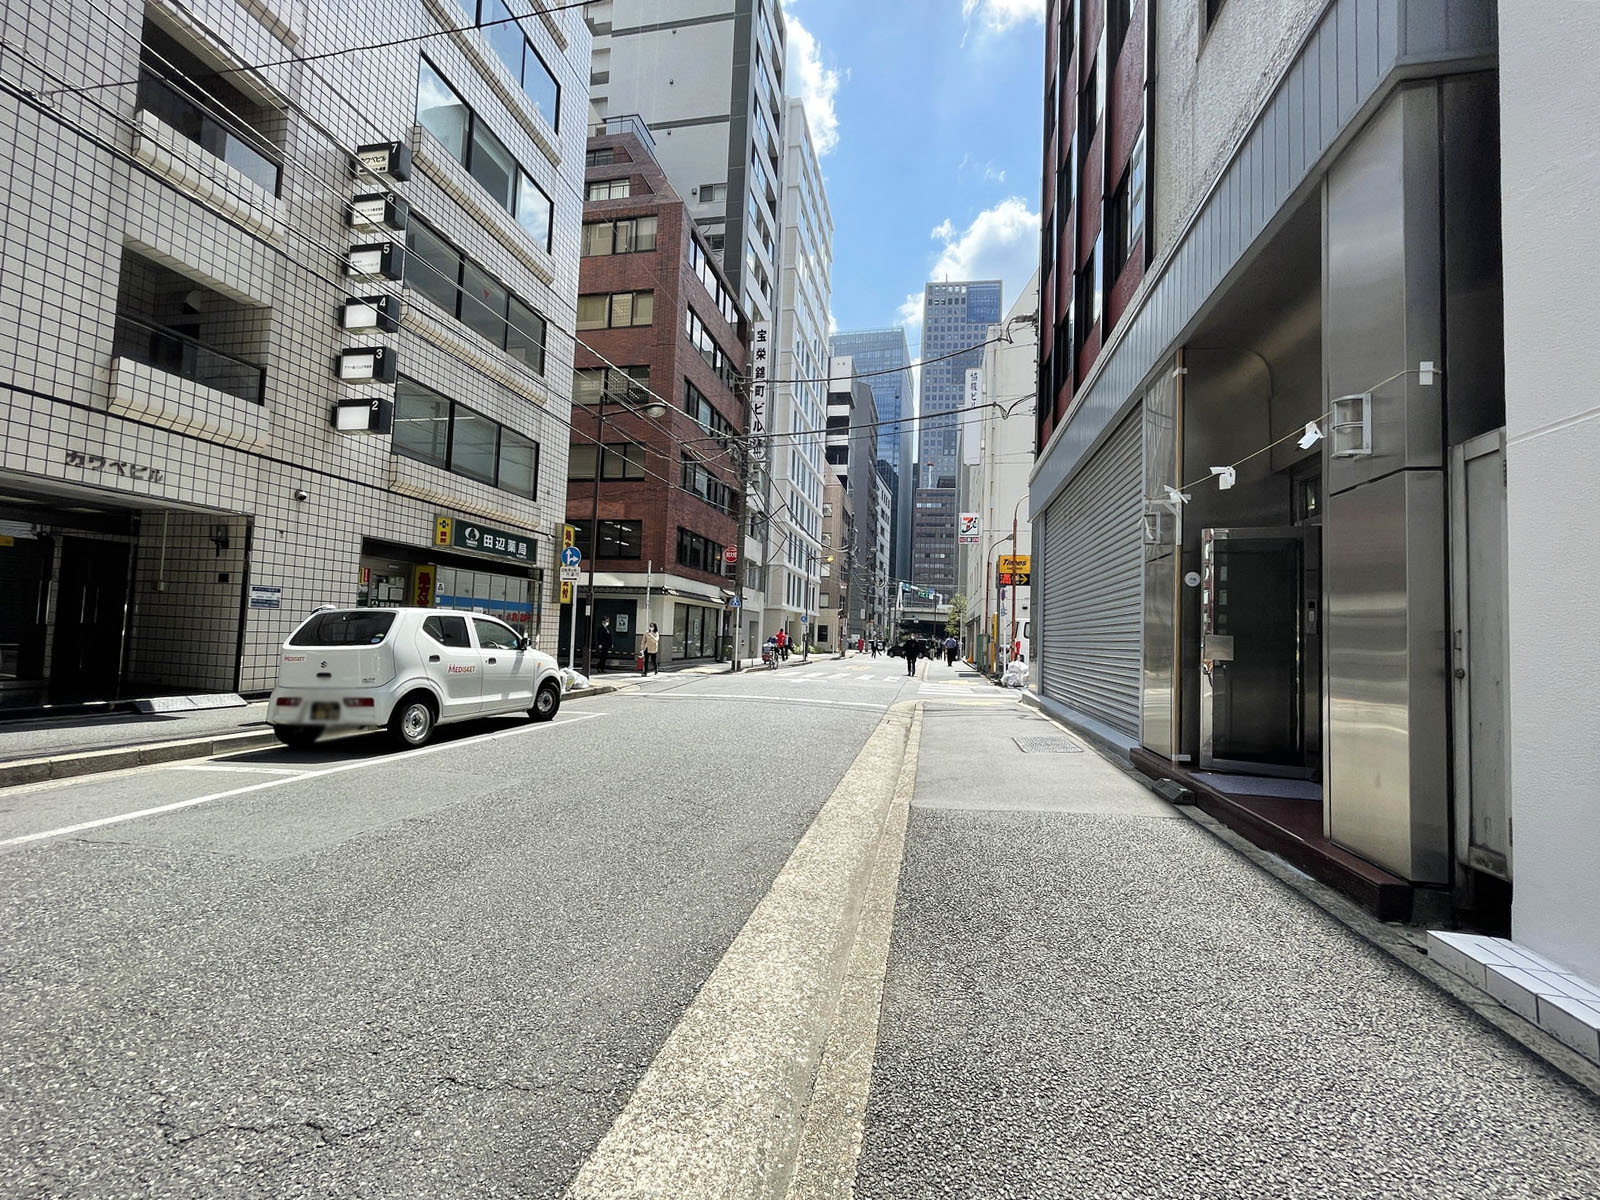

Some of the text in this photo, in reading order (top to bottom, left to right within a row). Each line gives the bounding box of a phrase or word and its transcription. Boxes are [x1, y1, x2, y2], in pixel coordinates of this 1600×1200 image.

[391, 143, 398, 153] 7
[387, 193, 394, 202] 6
[383, 244, 390, 254] 5
[379, 297, 386, 307] 4
[375, 349, 383, 359] 3
[371, 400, 379, 411] 2
[483, 533, 527, 556] 田辺薬局
